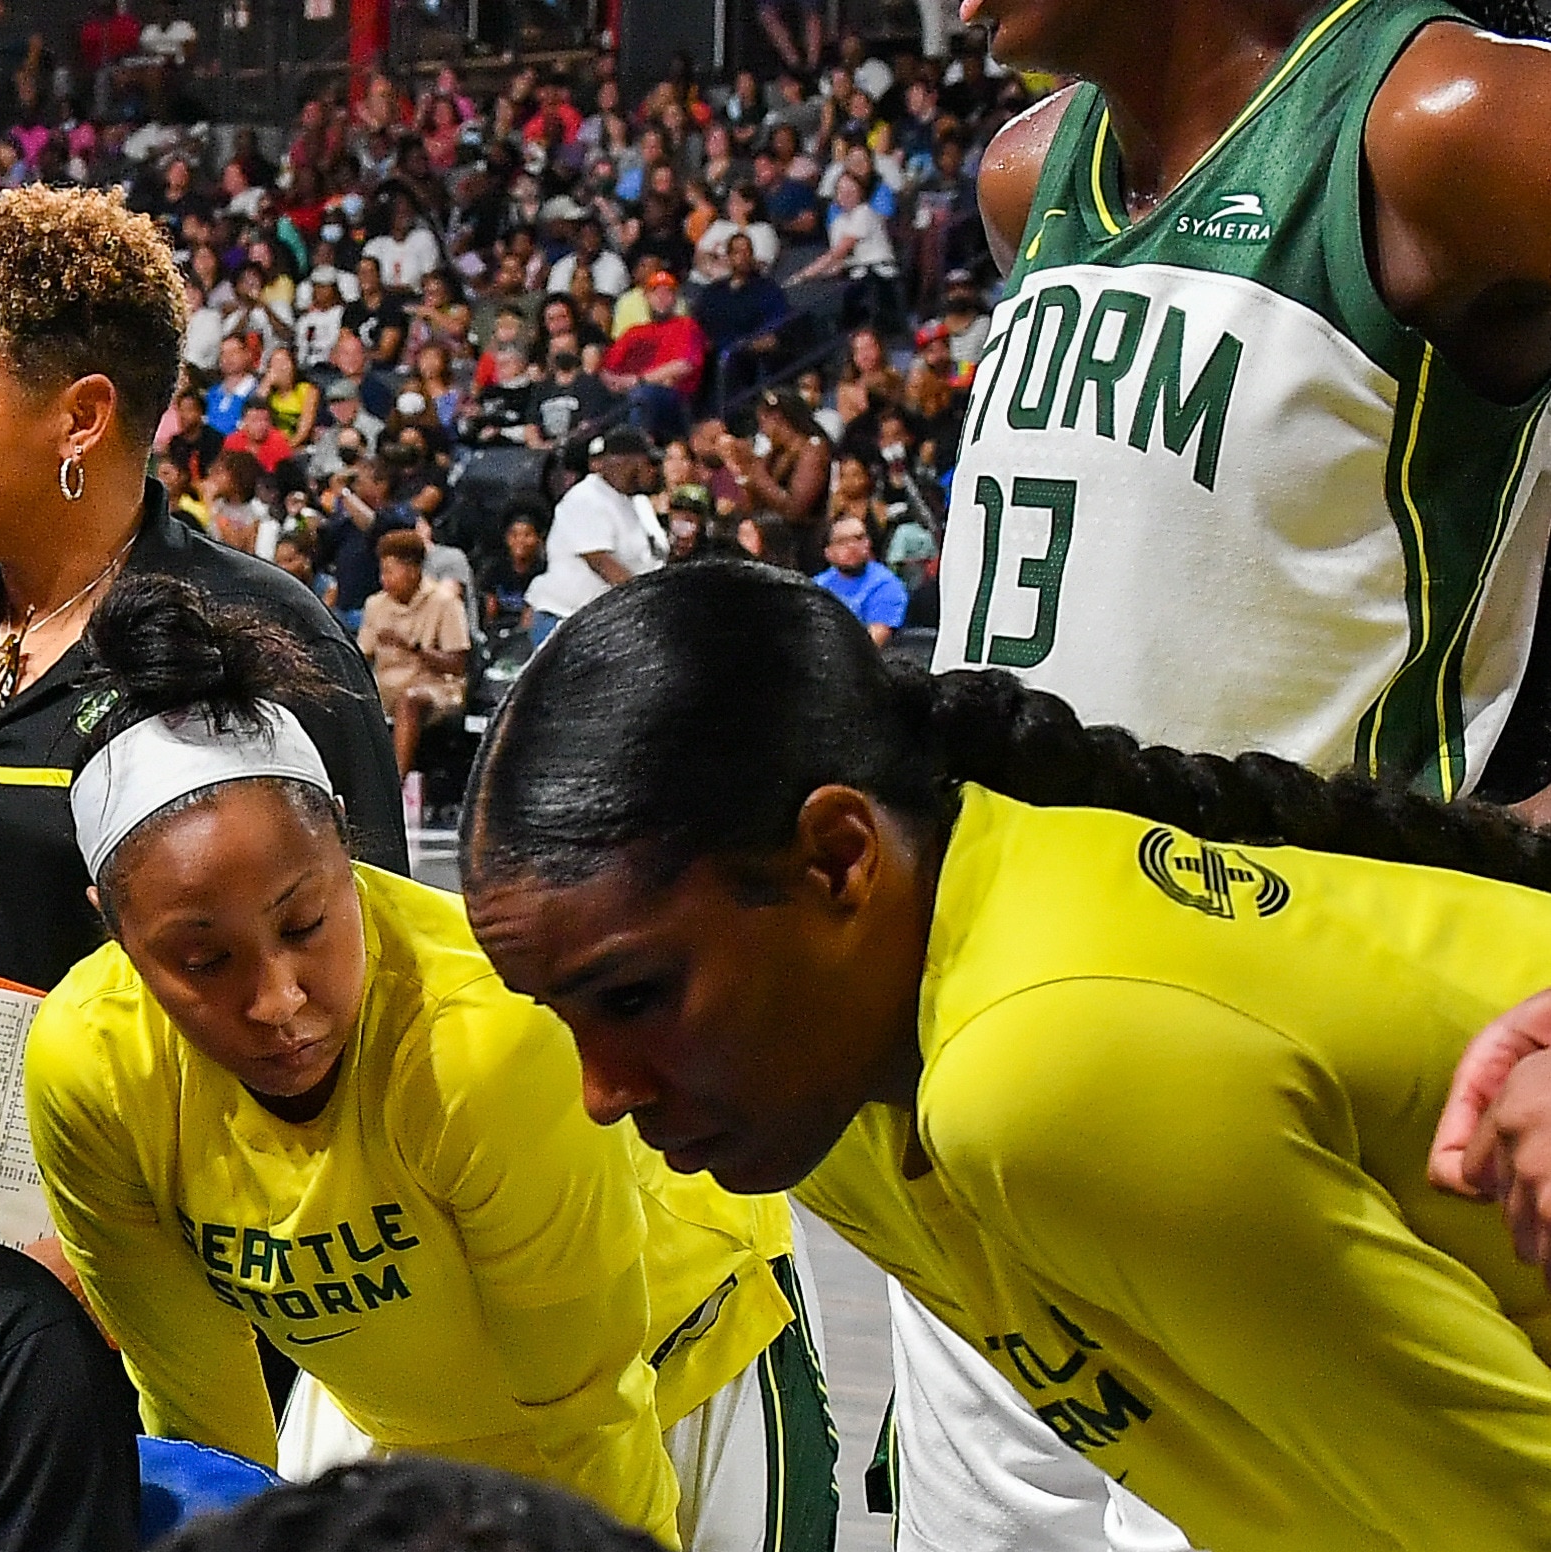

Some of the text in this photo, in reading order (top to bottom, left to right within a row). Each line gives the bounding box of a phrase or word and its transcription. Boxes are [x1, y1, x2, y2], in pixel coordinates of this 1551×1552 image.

[1177, 216, 1271, 240] SYMETRA
[971, 284, 1244, 492] TORM
[964, 475, 1078, 669] 13
[176, 1202, 421, 1284] SEATTLE
[205, 1263, 413, 1319] STORM
